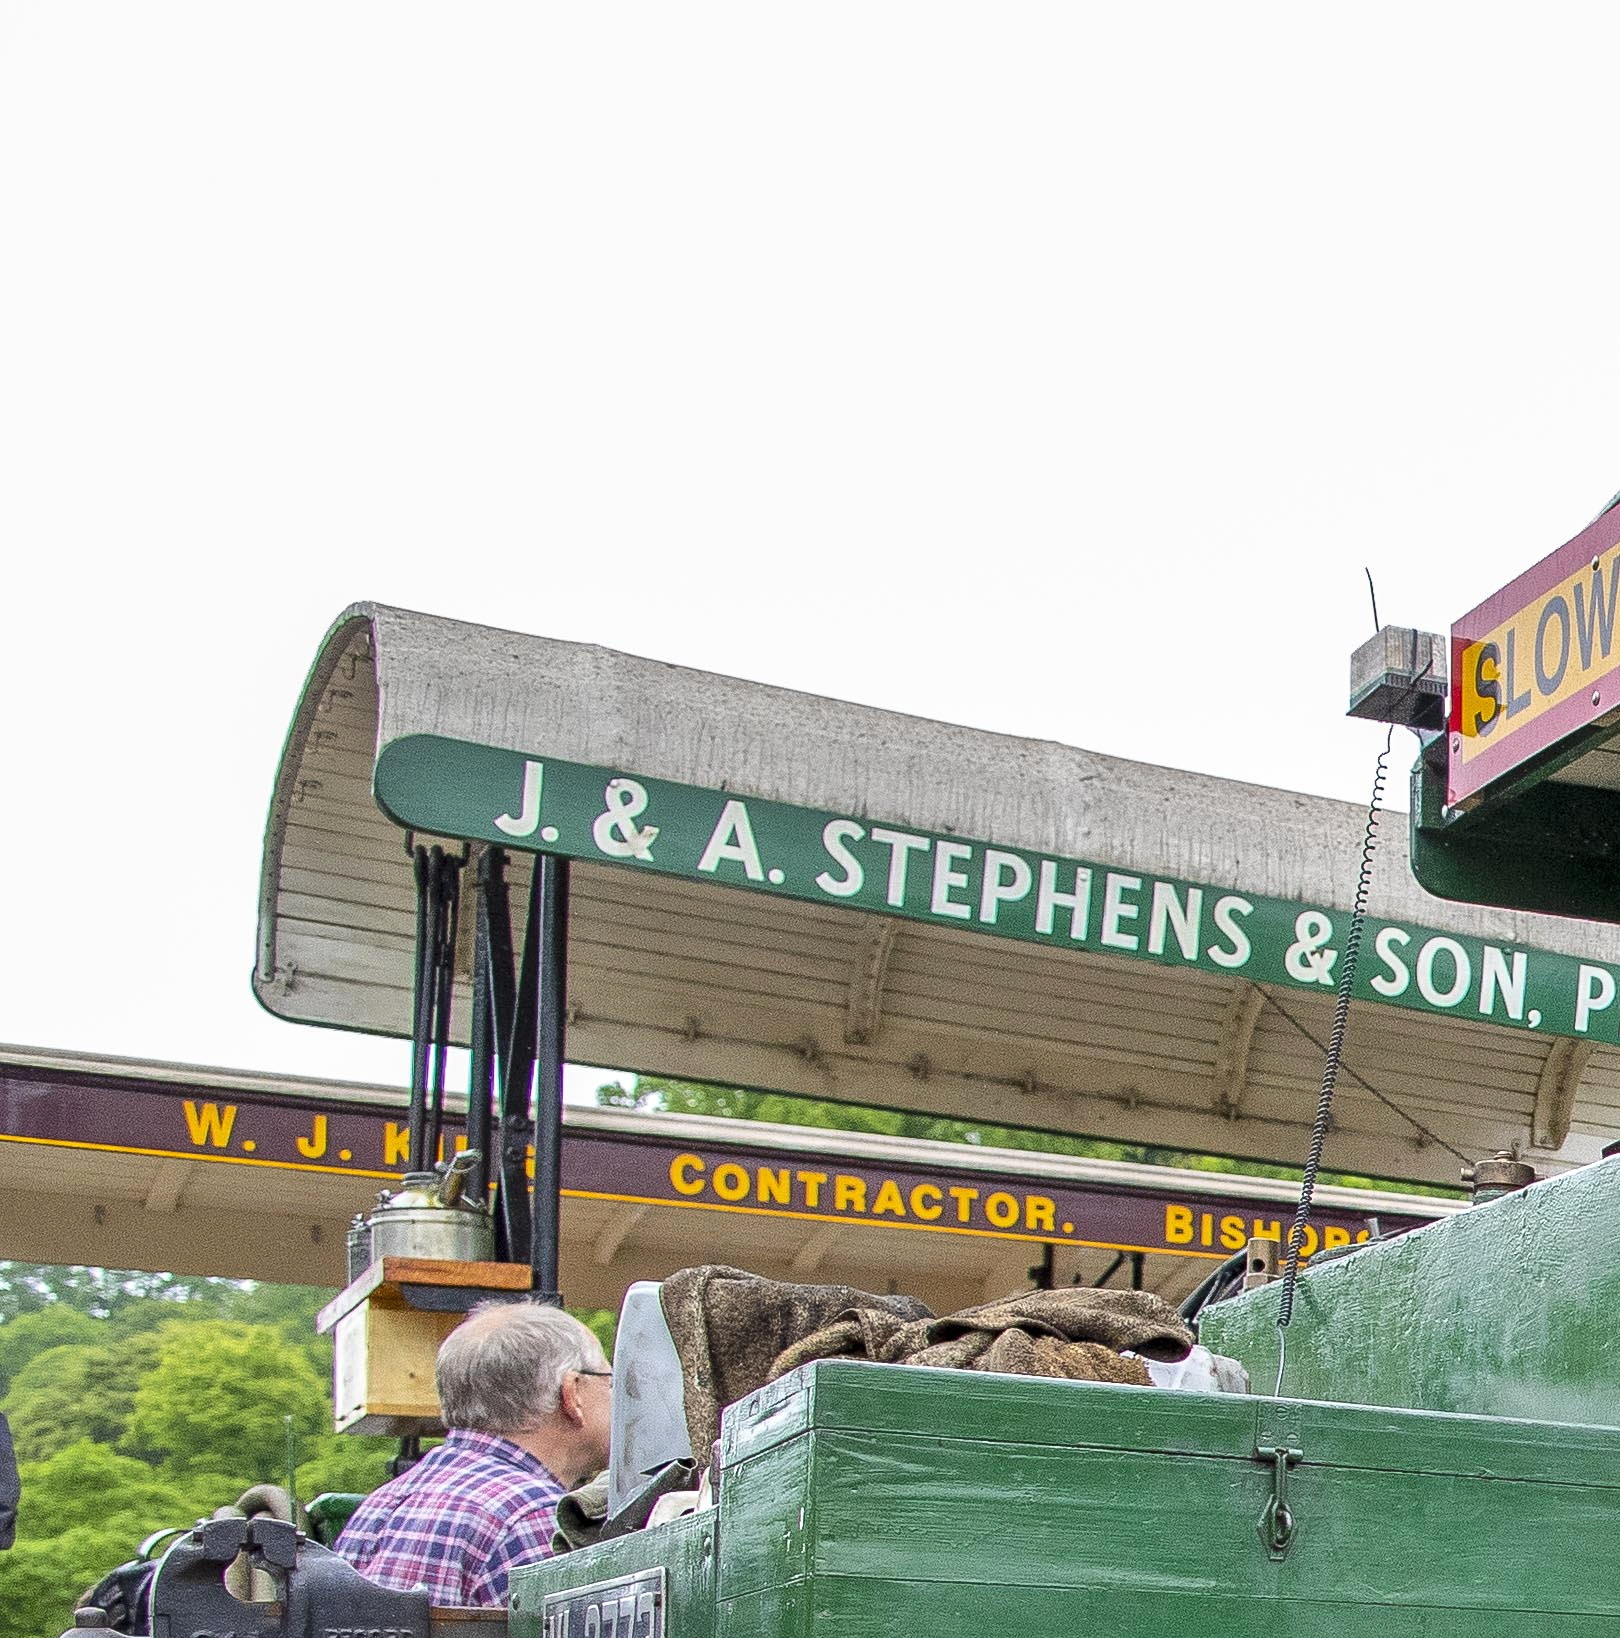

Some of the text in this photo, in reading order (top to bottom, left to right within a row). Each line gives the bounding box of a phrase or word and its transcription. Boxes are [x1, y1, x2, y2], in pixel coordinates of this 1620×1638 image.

[494, 760, 561, 843] J.
[592, 778, 660, 862] &
[697, 800, 786, 886] A.
[814, 817, 1254, 970] STEPHENS
[1284, 909, 1339, 987] &
[1370, 926, 1539, 1030] SON,
[183, 1100, 257, 1152] W.
[297, 1114, 353, 1162] J.
[668, 1152, 1076, 1234] CONTRACTOR.
